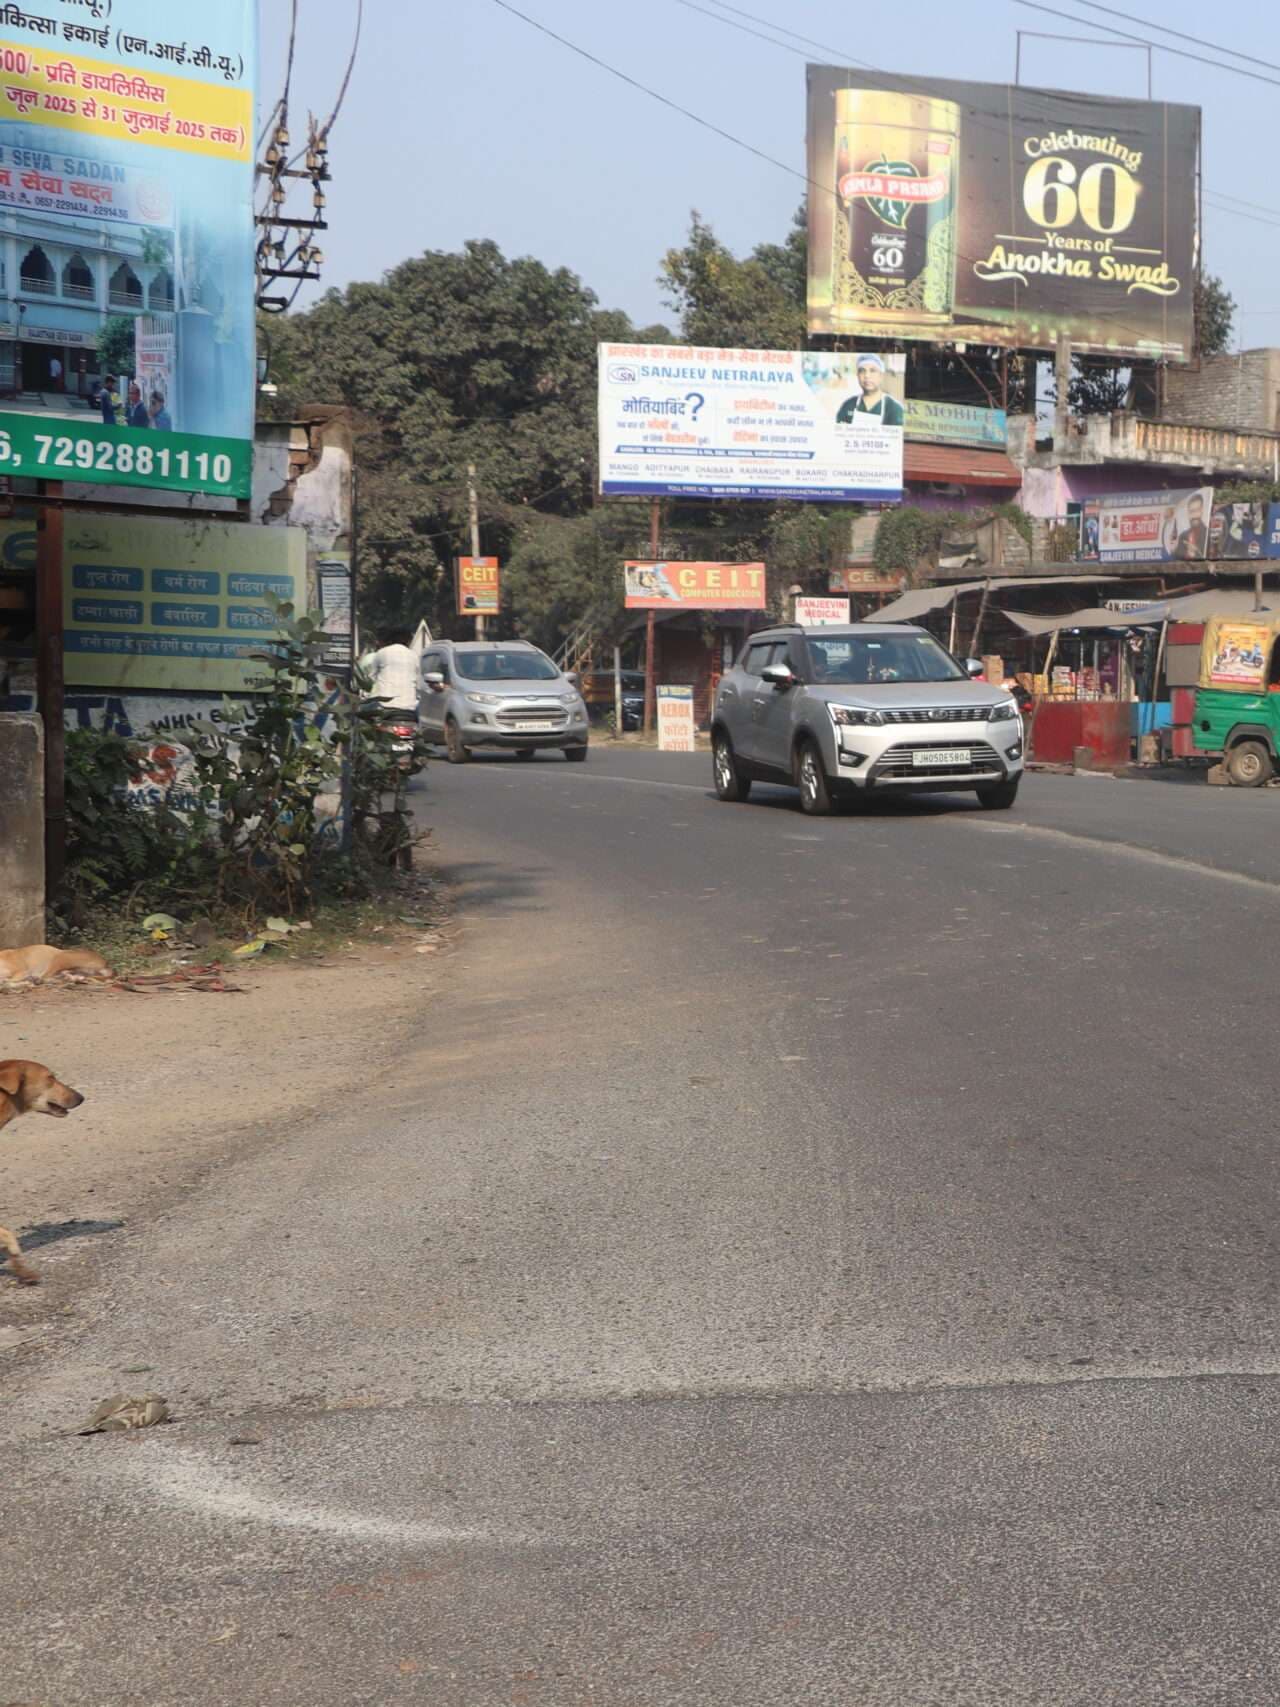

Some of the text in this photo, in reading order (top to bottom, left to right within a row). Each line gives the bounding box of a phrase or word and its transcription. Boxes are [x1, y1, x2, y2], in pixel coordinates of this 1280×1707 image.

[62, 21, 110, 49] इकाई
[45, 62, 76, 85] प्रति
[81, 71, 166, 103] डायलिसिस
[5, 86, 245, 151] जून 2025 से 31 जुलाई 2025 तक)
[1023, 129, 1142, 172] Celebrating
[20, 170, 63, 194] सेवा
[63, 158, 126, 183] SADAN
[1023, 156, 1137, 234] 60
[1043, 231, 1114, 253] Years of
[872, 247, 904, 269] 60
[976, 245, 1176, 288] Anokha Swad
[620, 371, 636, 382] SN
[640, 365, 795, 383] SANJEEV NETRALAYA
[34, 433, 232, 484] 7292881110
[463, 567, 497, 582] CEIT
[679, 568, 763, 588] CEIT
[804, 610, 841, 619] MEDICAL
